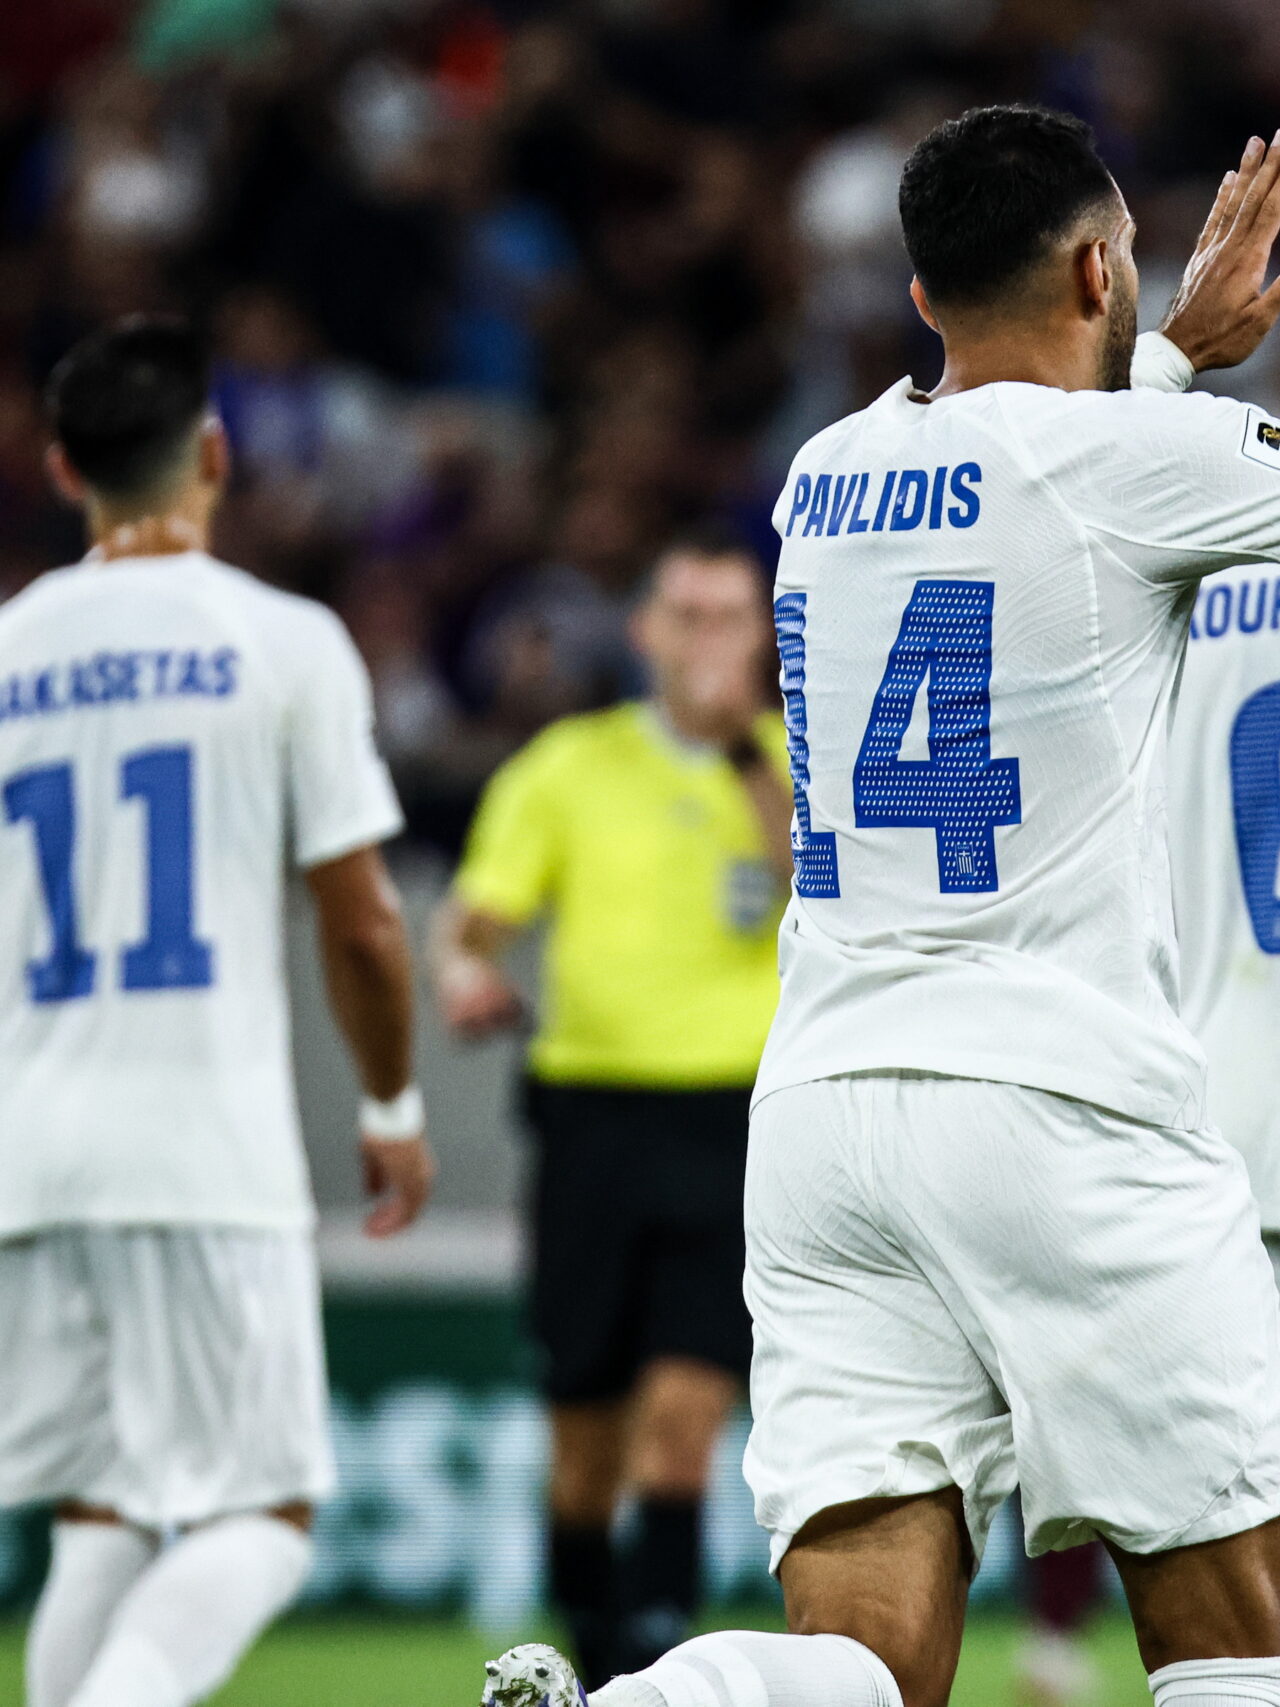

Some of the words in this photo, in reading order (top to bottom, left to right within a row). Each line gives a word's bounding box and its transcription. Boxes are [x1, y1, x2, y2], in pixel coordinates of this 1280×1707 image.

[785, 462, 982, 537] PAVLIDIS
[773, 579, 1022, 898] 14
[2, 741, 214, 1003] 11
